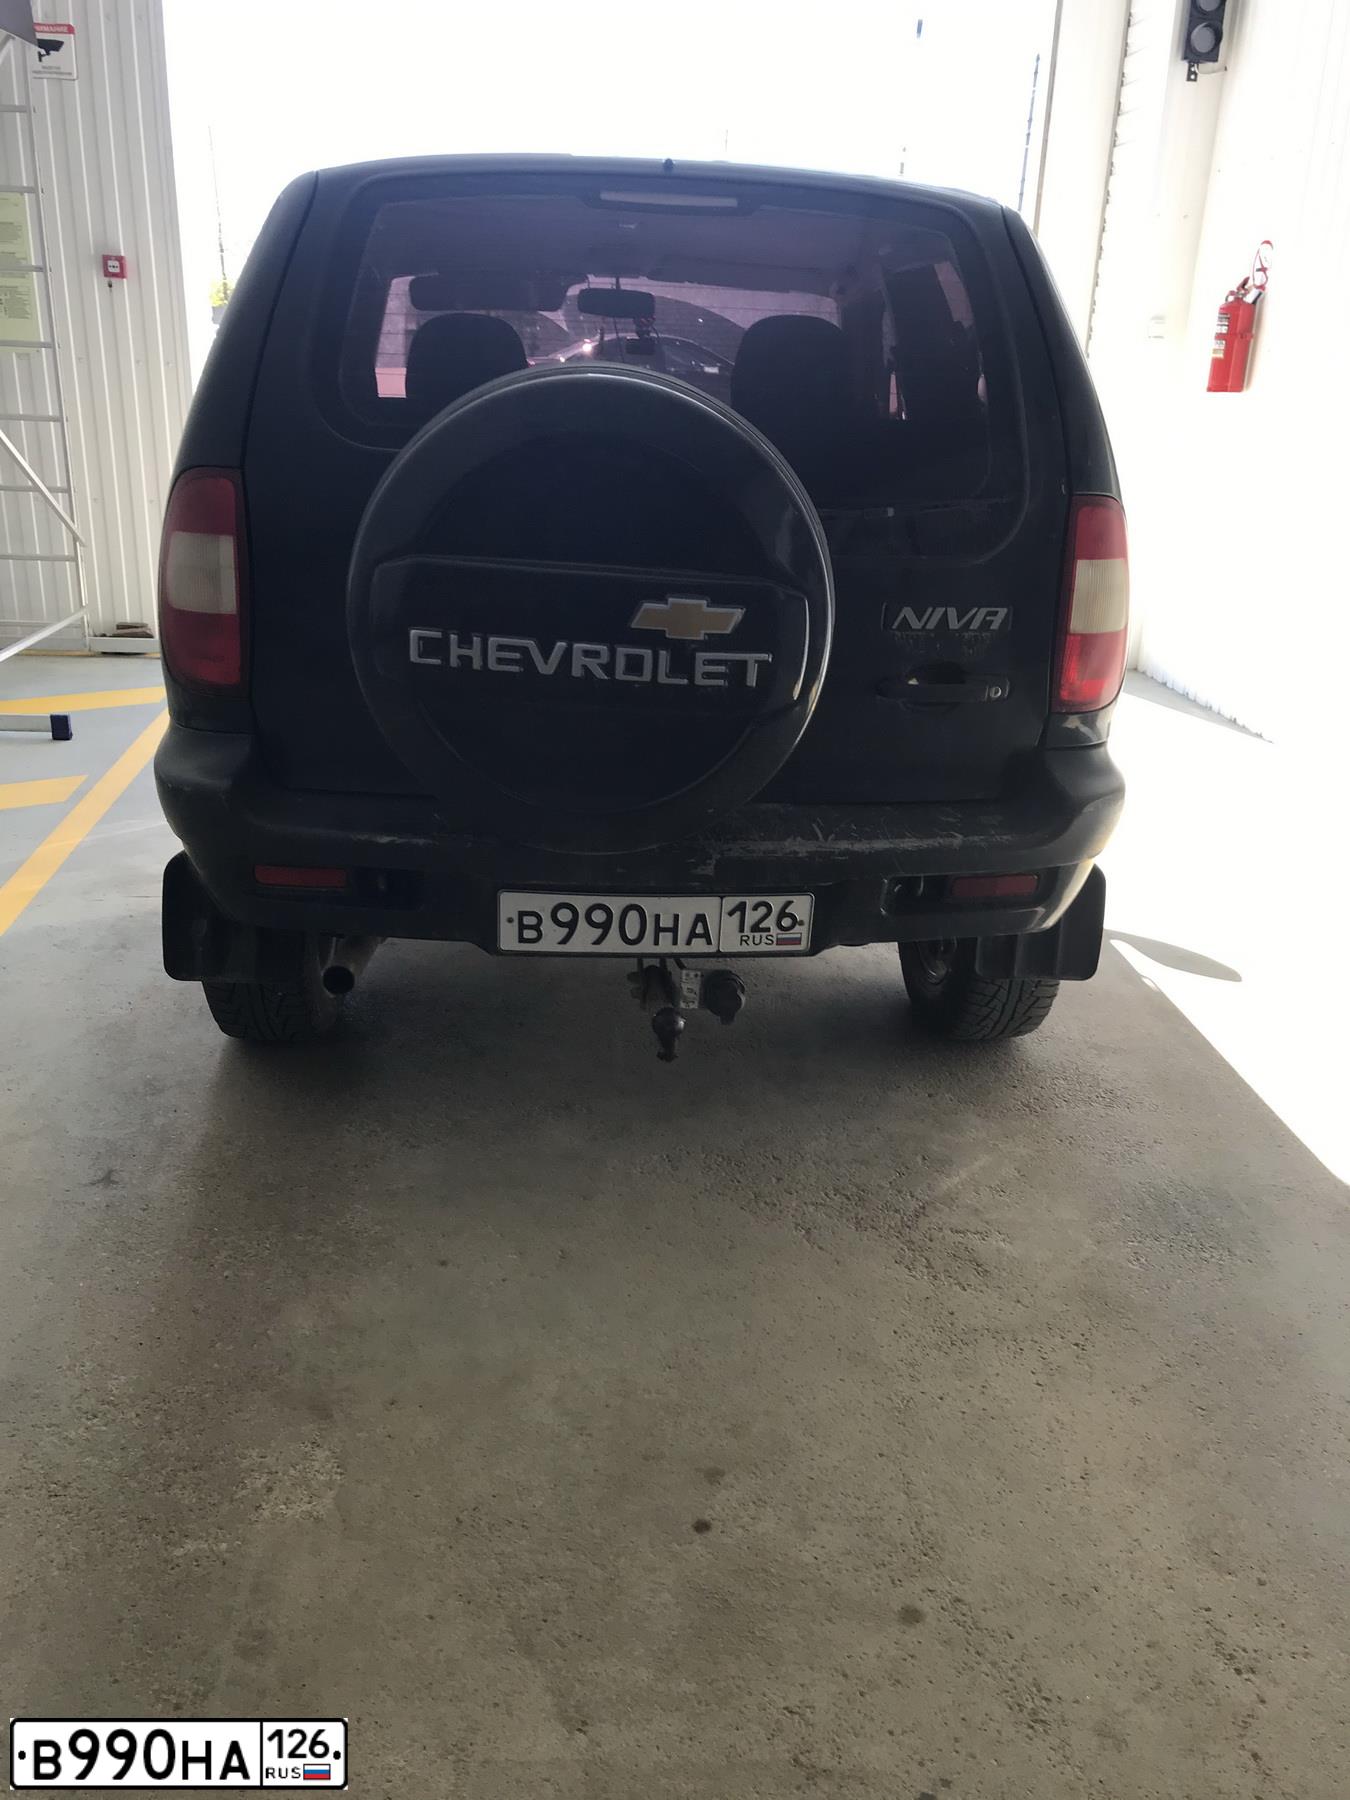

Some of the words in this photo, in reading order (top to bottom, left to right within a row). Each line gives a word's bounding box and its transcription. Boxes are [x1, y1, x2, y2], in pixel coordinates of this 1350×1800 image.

[891, 606, 1009, 631] NIVA
[408, 629, 772, 688] CHEVROLET
[727, 900, 799, 933] 126
[739, 934, 774, 947] RUS
